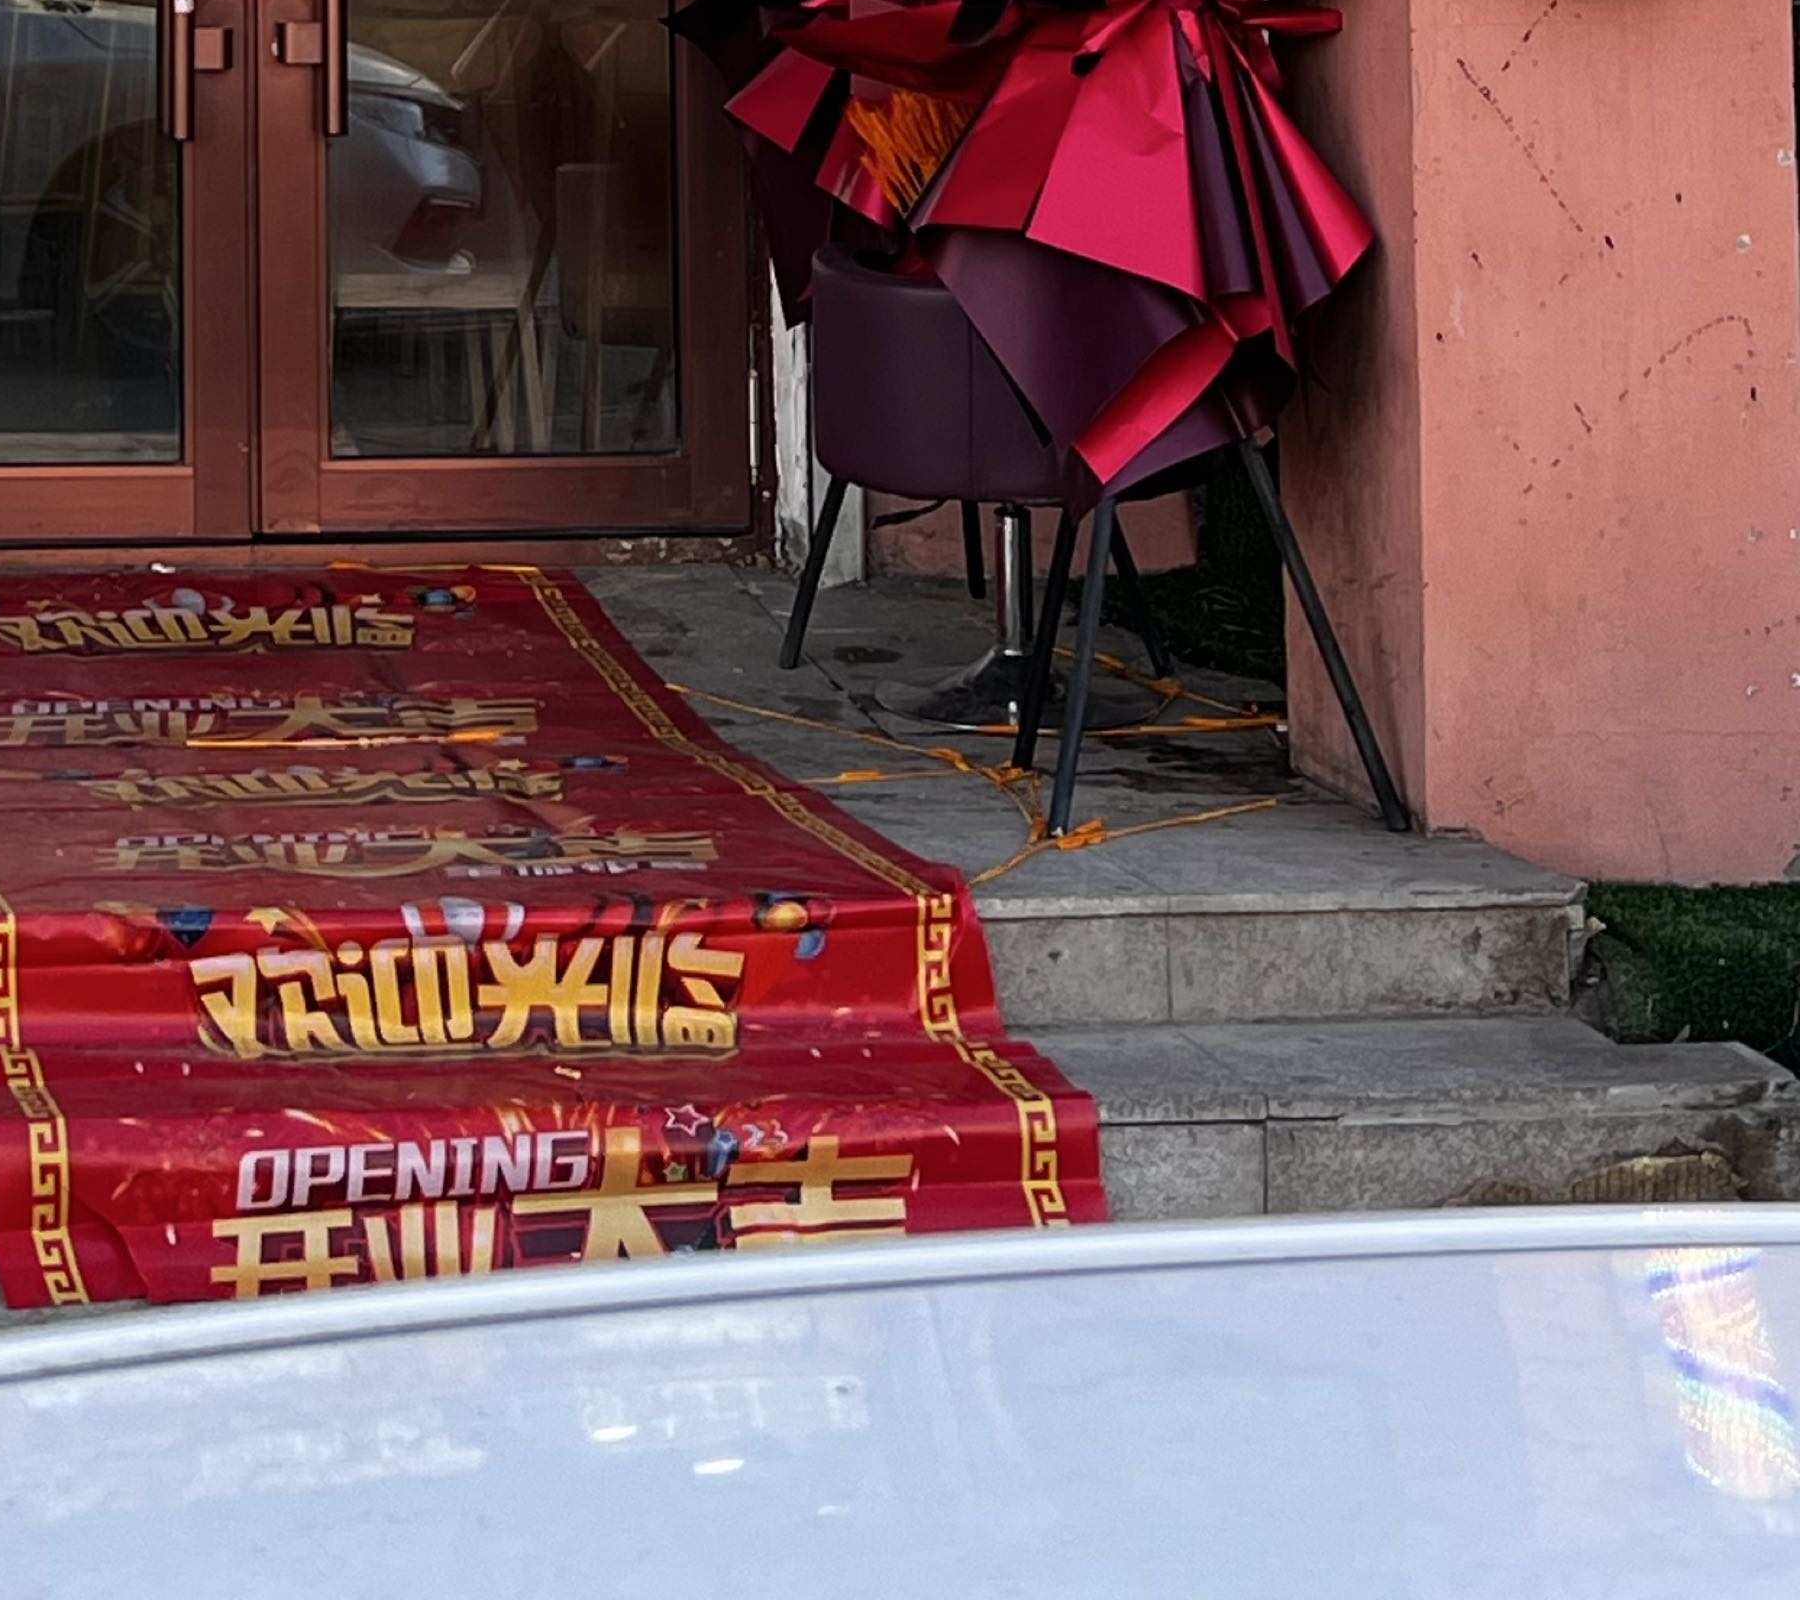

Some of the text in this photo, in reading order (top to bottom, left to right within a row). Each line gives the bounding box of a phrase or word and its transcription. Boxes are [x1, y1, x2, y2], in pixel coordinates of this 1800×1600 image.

[188, 933, 745, 1058] 欢迎光临
[237, 1130, 591, 1211] OPENING
